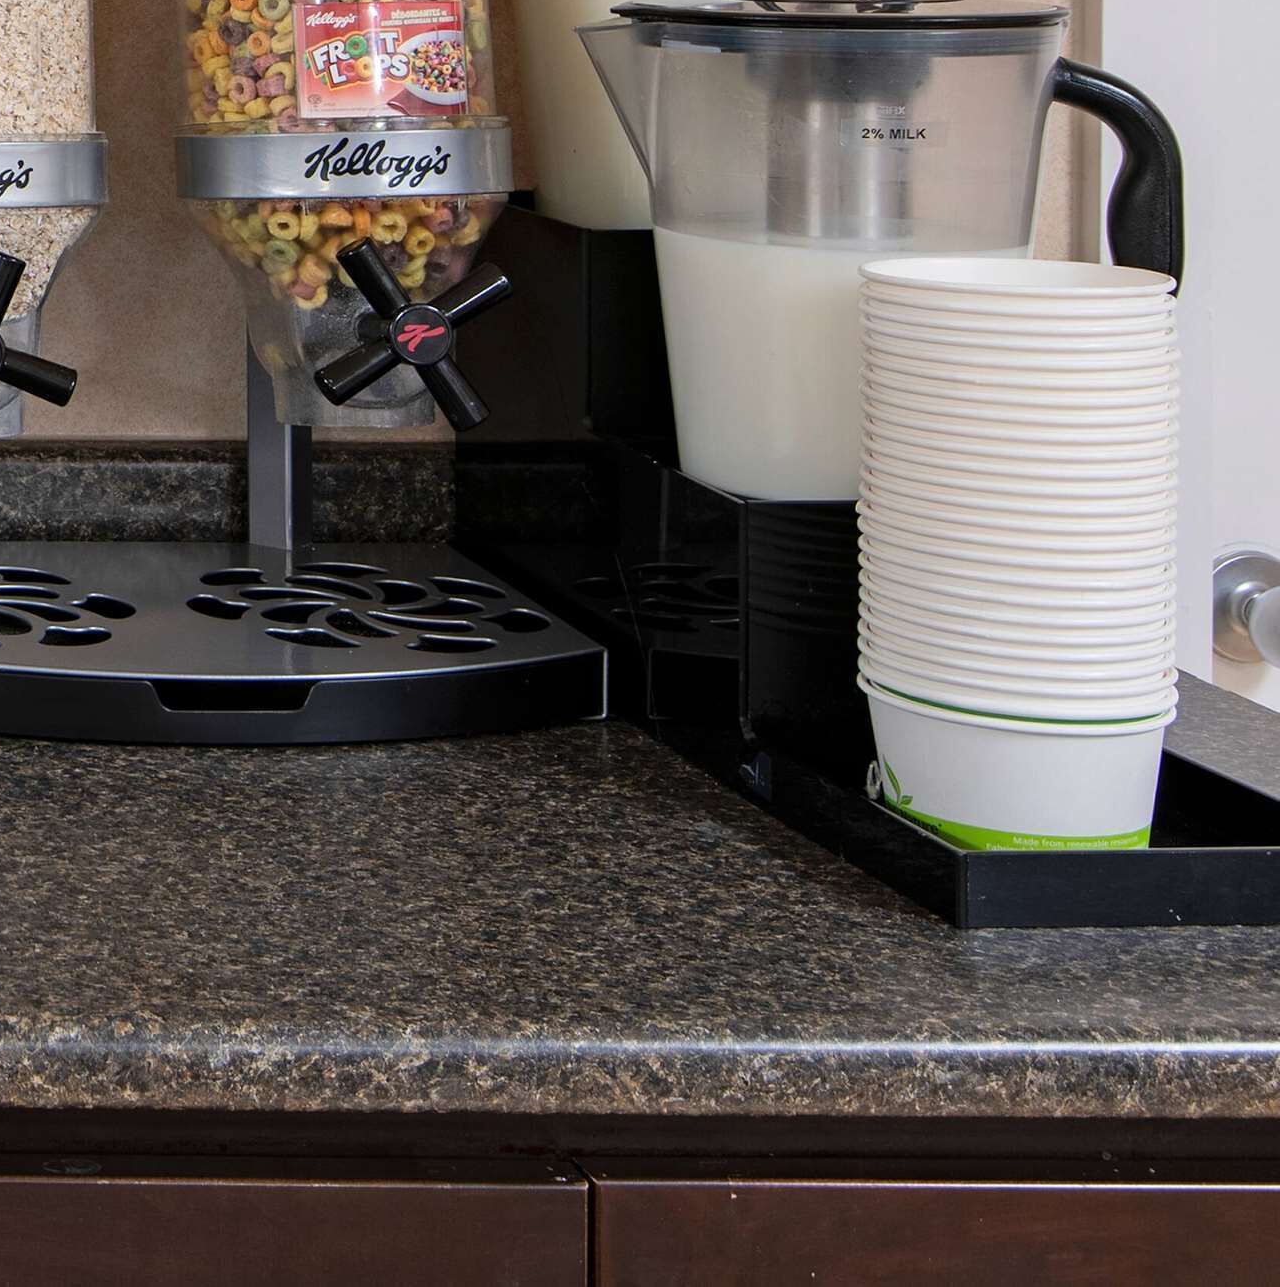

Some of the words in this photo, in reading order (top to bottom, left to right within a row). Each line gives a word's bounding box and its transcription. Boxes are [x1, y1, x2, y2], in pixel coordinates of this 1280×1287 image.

[305, 10, 357, 28] Kellogg's
[861, 128, 884, 139] 2%
[889, 128, 927, 139] MILK
[304, 138, 451, 188] Kellogg's
